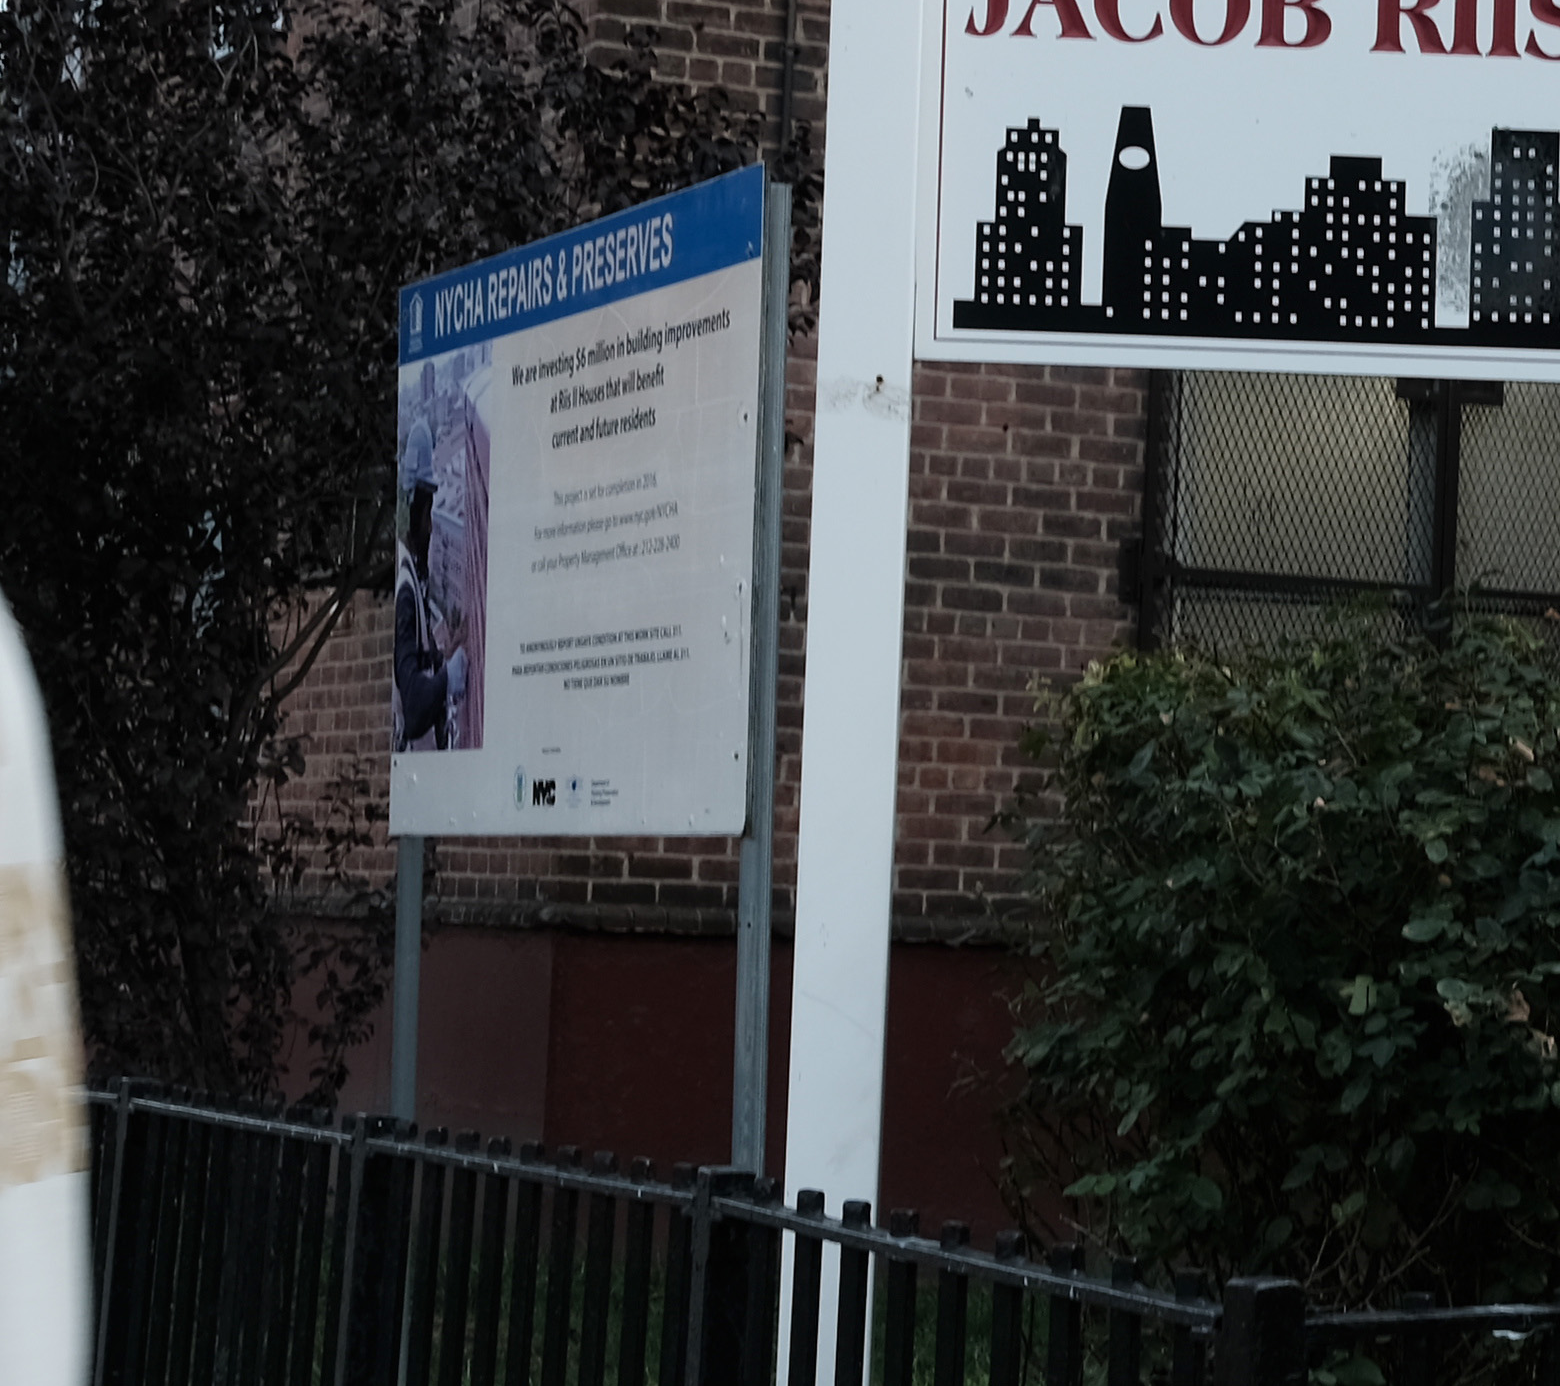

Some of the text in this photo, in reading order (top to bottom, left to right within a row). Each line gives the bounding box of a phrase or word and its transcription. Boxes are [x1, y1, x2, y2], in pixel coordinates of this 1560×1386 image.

[435, 213, 673, 338] NYCHA REPAIRS & PRESERVES
[511, 308, 731, 386] We are investing $6 million in building improvements
[550, 393, 558, 413] at
[558, 389, 572, 411] Riis
[578, 385, 606, 406] Houses
[605, 376, 621, 399] that
[621, 370, 636, 395] will
[636, 363, 665, 391] benefit
[551, 407, 656, 449] current and future residents
[532, 779, 557, 807] NYC
